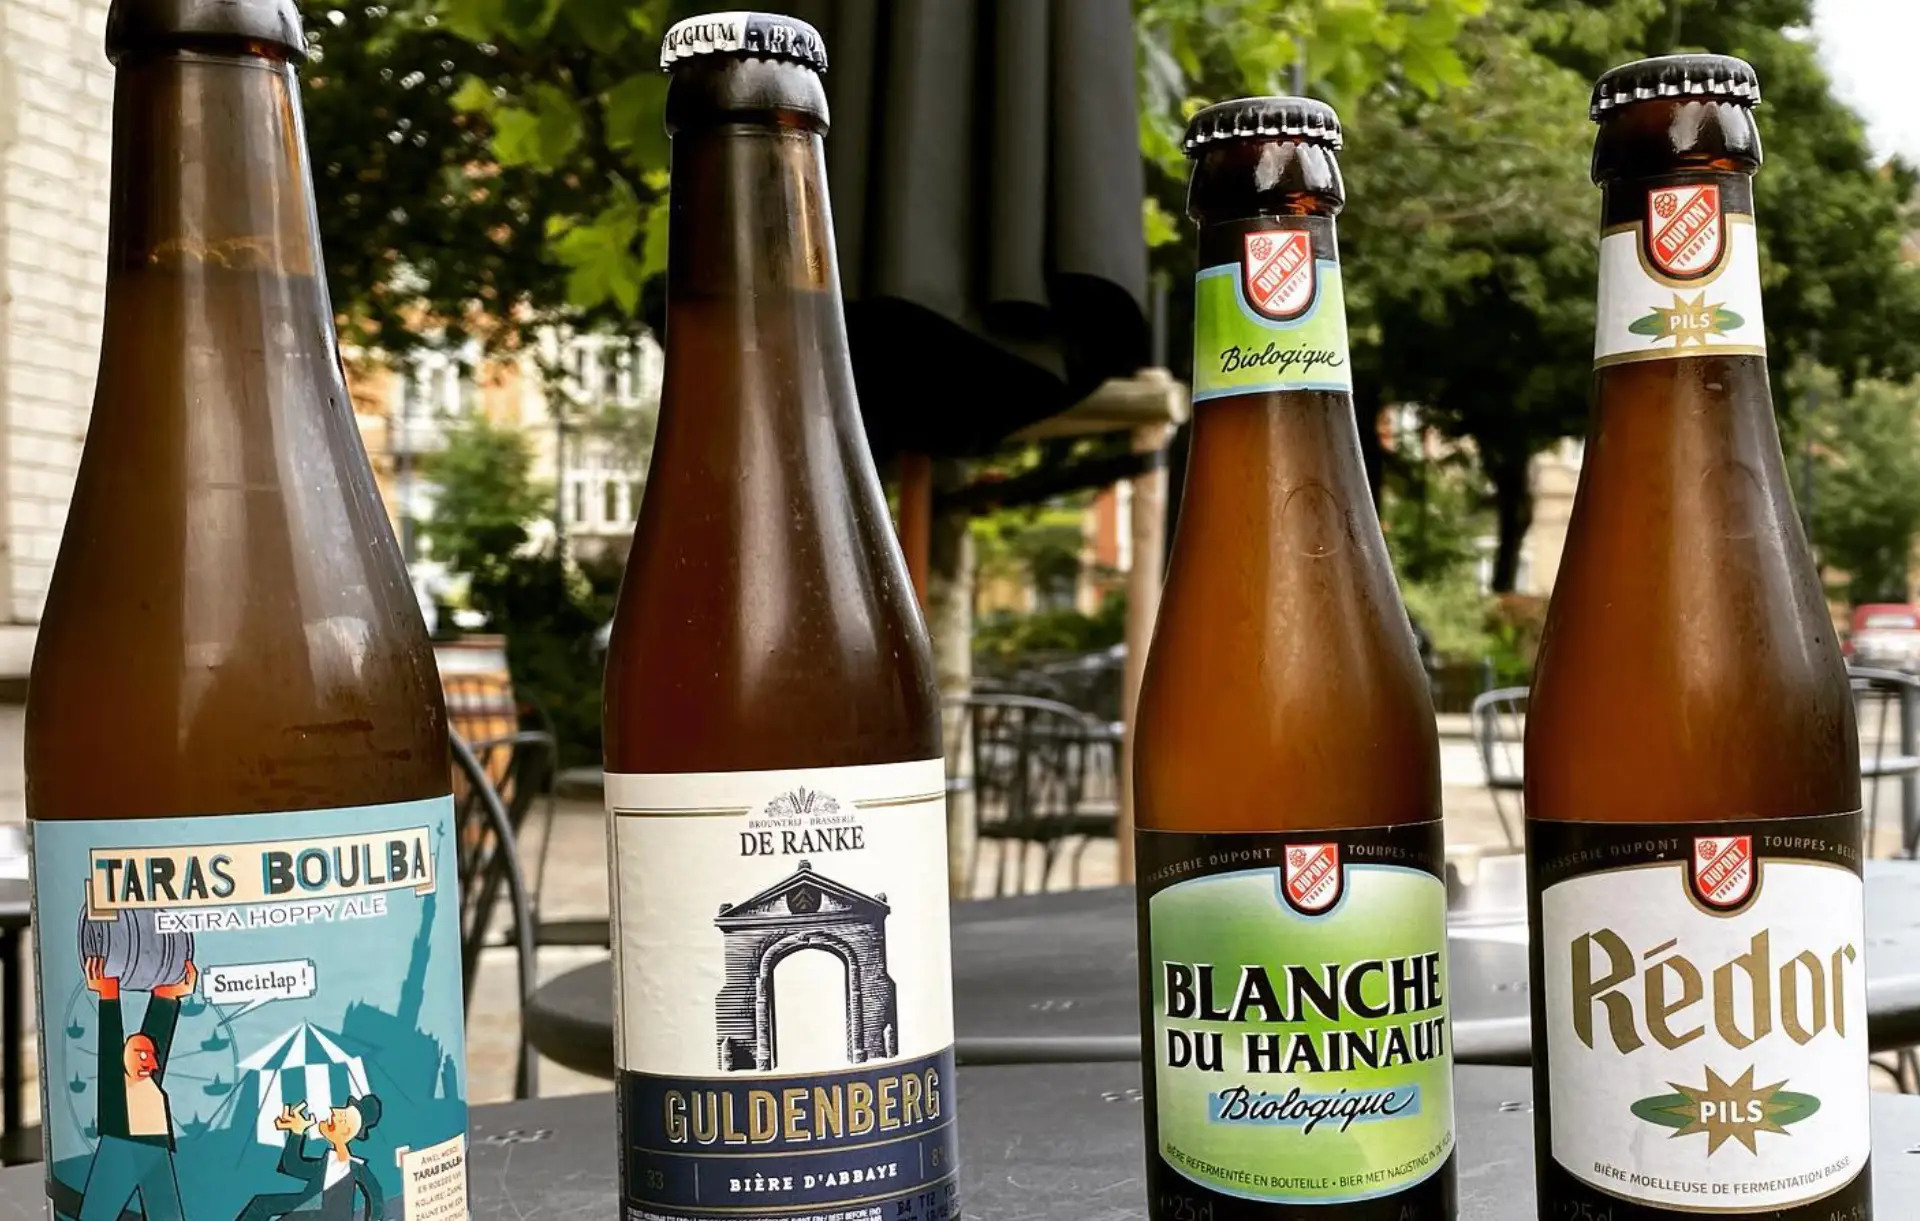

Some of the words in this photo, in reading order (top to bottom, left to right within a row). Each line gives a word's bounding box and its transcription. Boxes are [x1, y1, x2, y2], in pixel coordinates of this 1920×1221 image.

[664, 22, 736, 50] ELGIUM
[1660, 197, 1713, 252] DUPONT
[1256, 243, 1306, 293] DUPONT
[1670, 313, 1711, 330] PILS
[1219, 341, 1345, 375] Biologique
[810, 814, 857, 826] BRASSERIE
[739, 831, 775, 857] DE
[780, 825, 866, 855] RANKE
[1208, 848, 1273, 866] DUPONT
[1347, 844, 1406, 859] TOURPES
[1540, 847, 1605, 874] ASSERIE
[1610, 838, 1680, 857] DUPONT
[1763, 835, 1826, 851] TOURPES
[95, 853, 236, 903] TARAS
[261, 837, 427, 896] BOULBA
[1293, 852, 1332, 894] DUPONT
[1703, 845, 1746, 887] DUPONT
[157, 911, 242, 931] EXTRA
[249, 903, 336, 926] HOPPY
[343, 896, 386, 917] ALE
[1162, 952, 1443, 1023] BLANCHE
[1571, 928, 1858, 1055] Rédor
[1165, 1027, 1225, 1073] DU
[1242, 1016, 1445, 1074] HAINAUT
[664, 1066, 940, 1145] GULDENBERG
[1217, 1084, 1416, 1136] Biologique
[1699, 1099, 1764, 1125] PILS
[412, 1164, 440, 1182] TARAS
[729, 1172, 794, 1192] BIÈRE
[803, 1163, 899, 1189] D'ABBAYE
[1185, 1156, 1252, 1184] REFERMENTÉE
[1254, 1174, 1269, 1187] EN
[1271, 1176, 1329, 1190] BOUTEILLE
[1339, 1174, 1364, 1188] BIER
[1365, 1171, 1385, 1185] MET
[1387, 1153, 1429, 1179] NAGISTING
[1593, 1161, 1627, 1182] BIÈRE
[1629, 1172, 1708, 1194] MOELLEUSE
[1711, 1182, 1730, 1195] DE
[1733, 1169, 1824, 1195] FERMENTATION
[1824, 1155, 1852, 1178] BASSE
